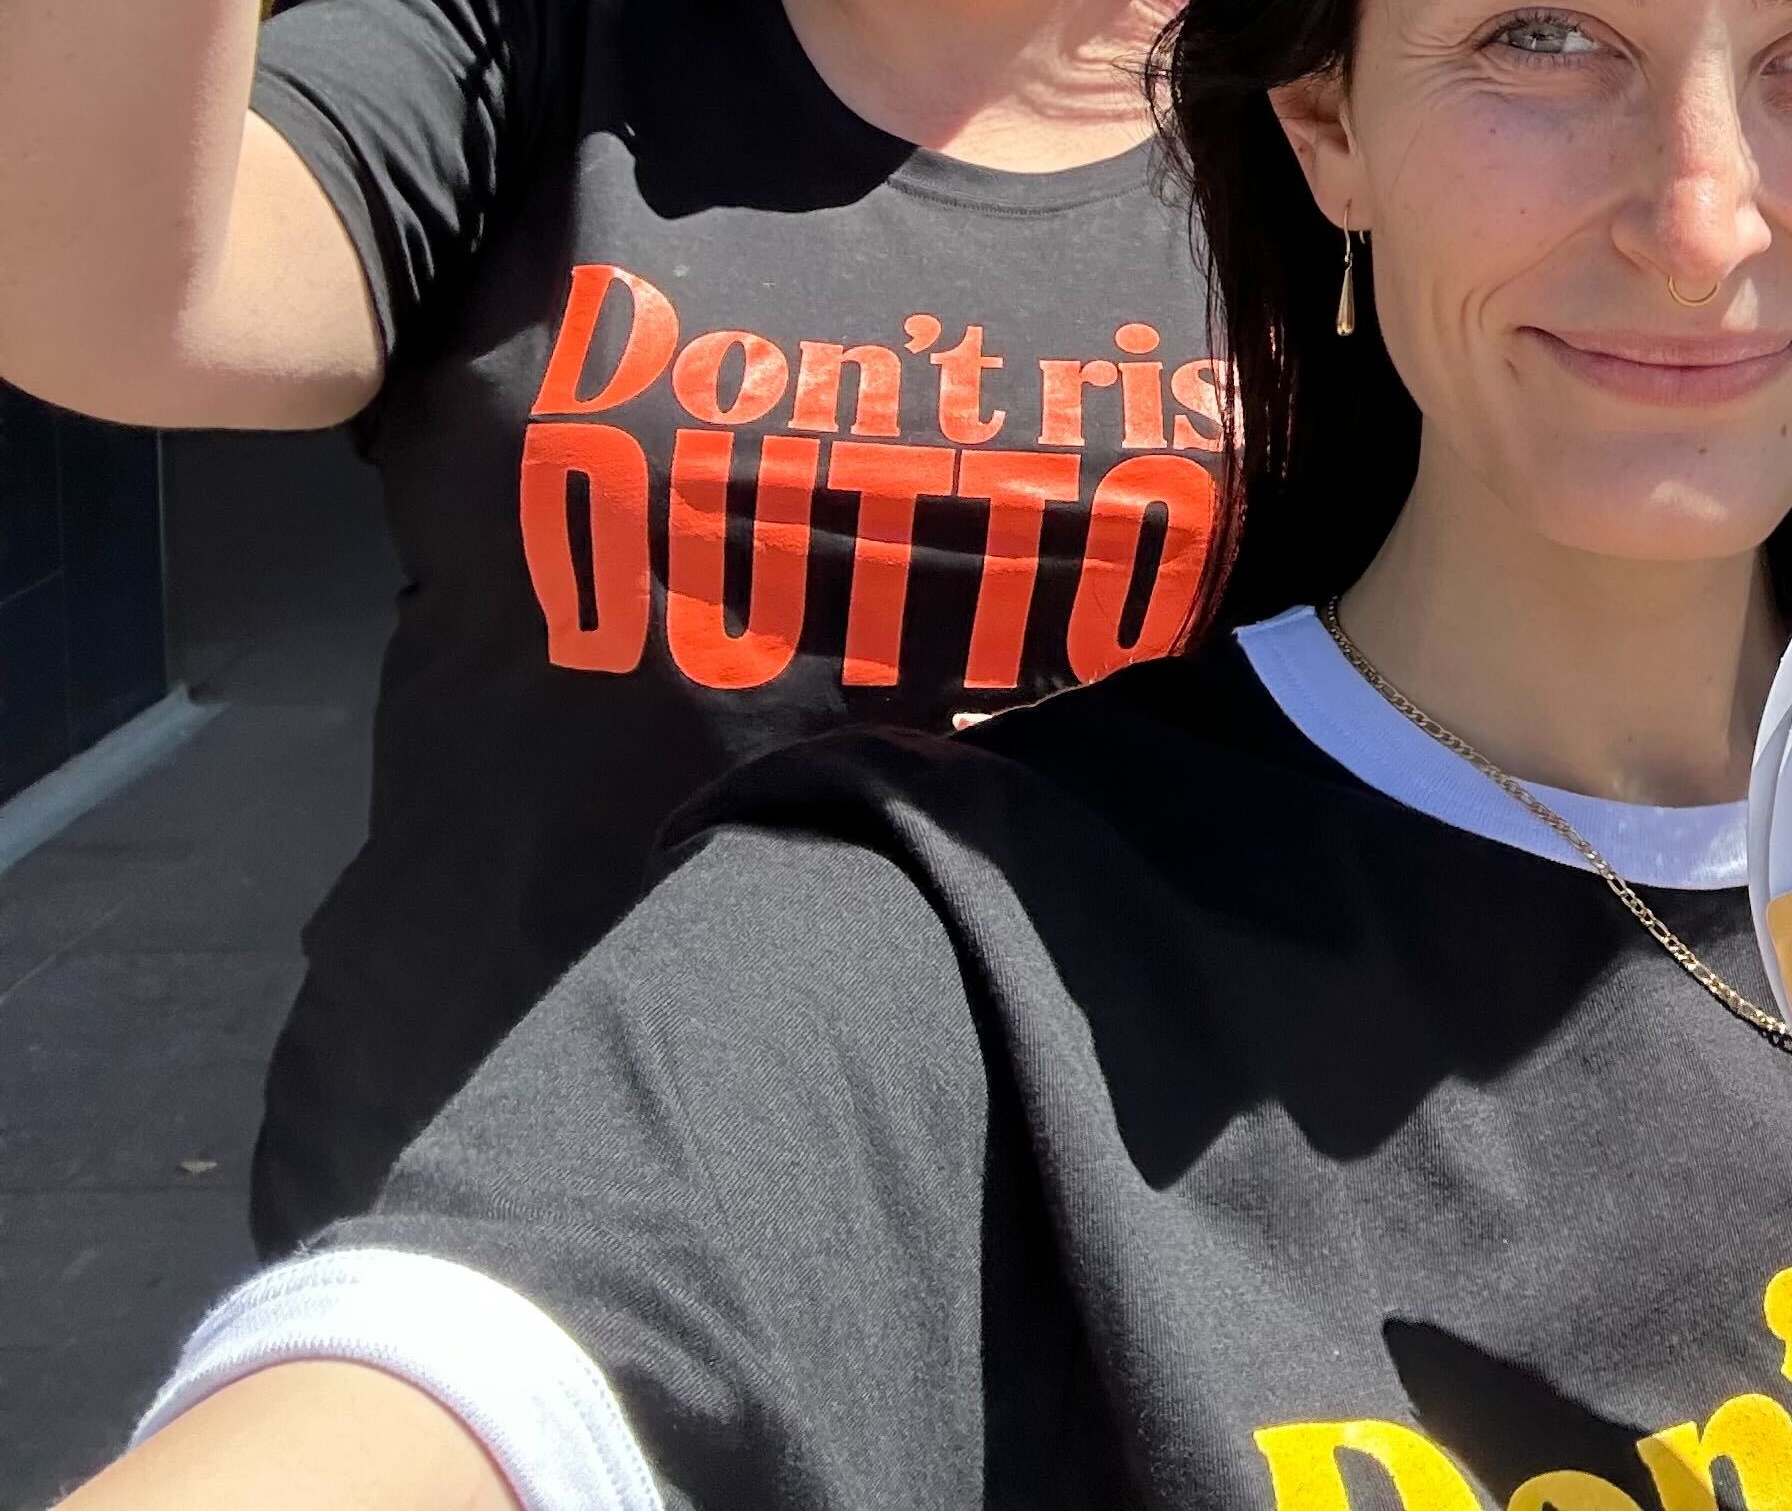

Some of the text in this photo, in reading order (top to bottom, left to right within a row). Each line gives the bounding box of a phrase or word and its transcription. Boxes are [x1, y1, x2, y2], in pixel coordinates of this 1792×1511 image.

[530, 264, 1232, 454] Don't ris
[519, 421, 1218, 690] DUTTO
